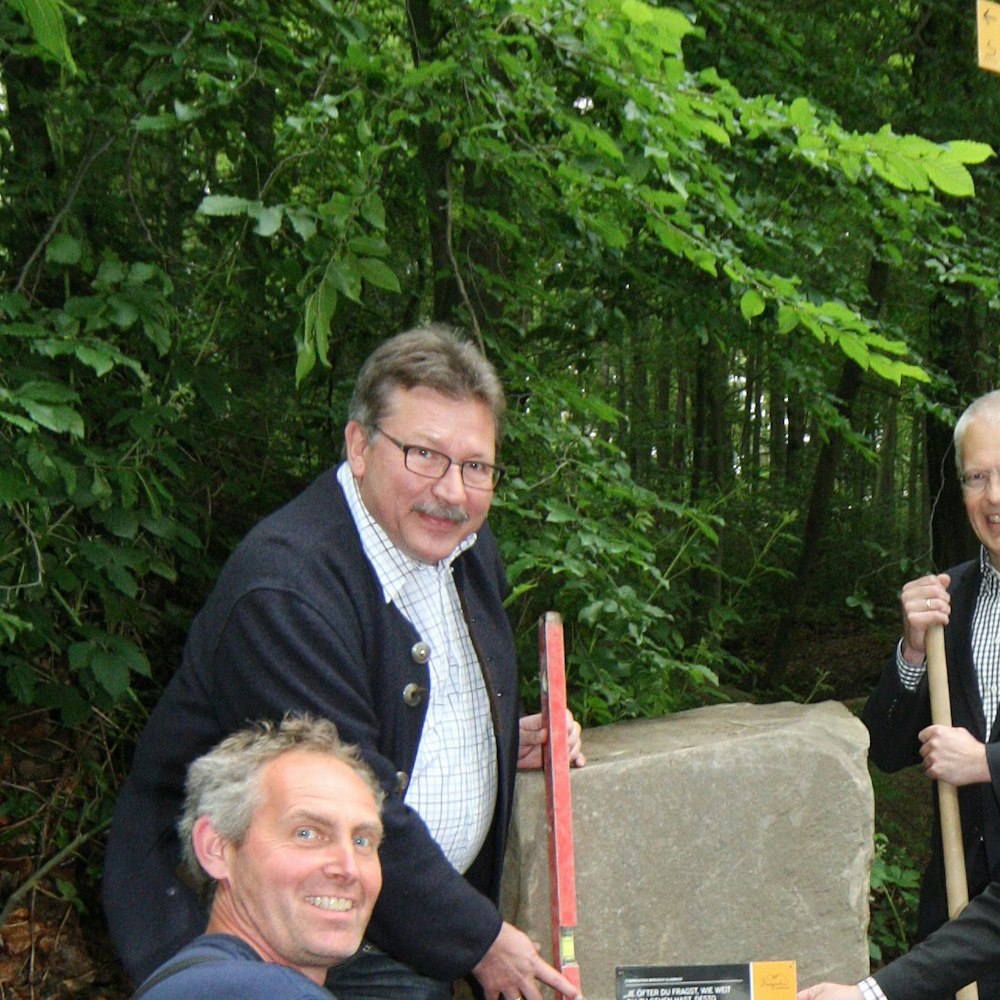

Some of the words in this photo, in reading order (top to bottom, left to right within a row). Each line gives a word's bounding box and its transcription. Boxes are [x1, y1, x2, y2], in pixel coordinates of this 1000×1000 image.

[636, 988, 659, 997] ÖFTER
[660, 988, 671, 997] DU
[671, 986, 700, 996] FRAGST,
[700, 986, 714, 995] WIE
[714, 985, 732, 995] WEIT
